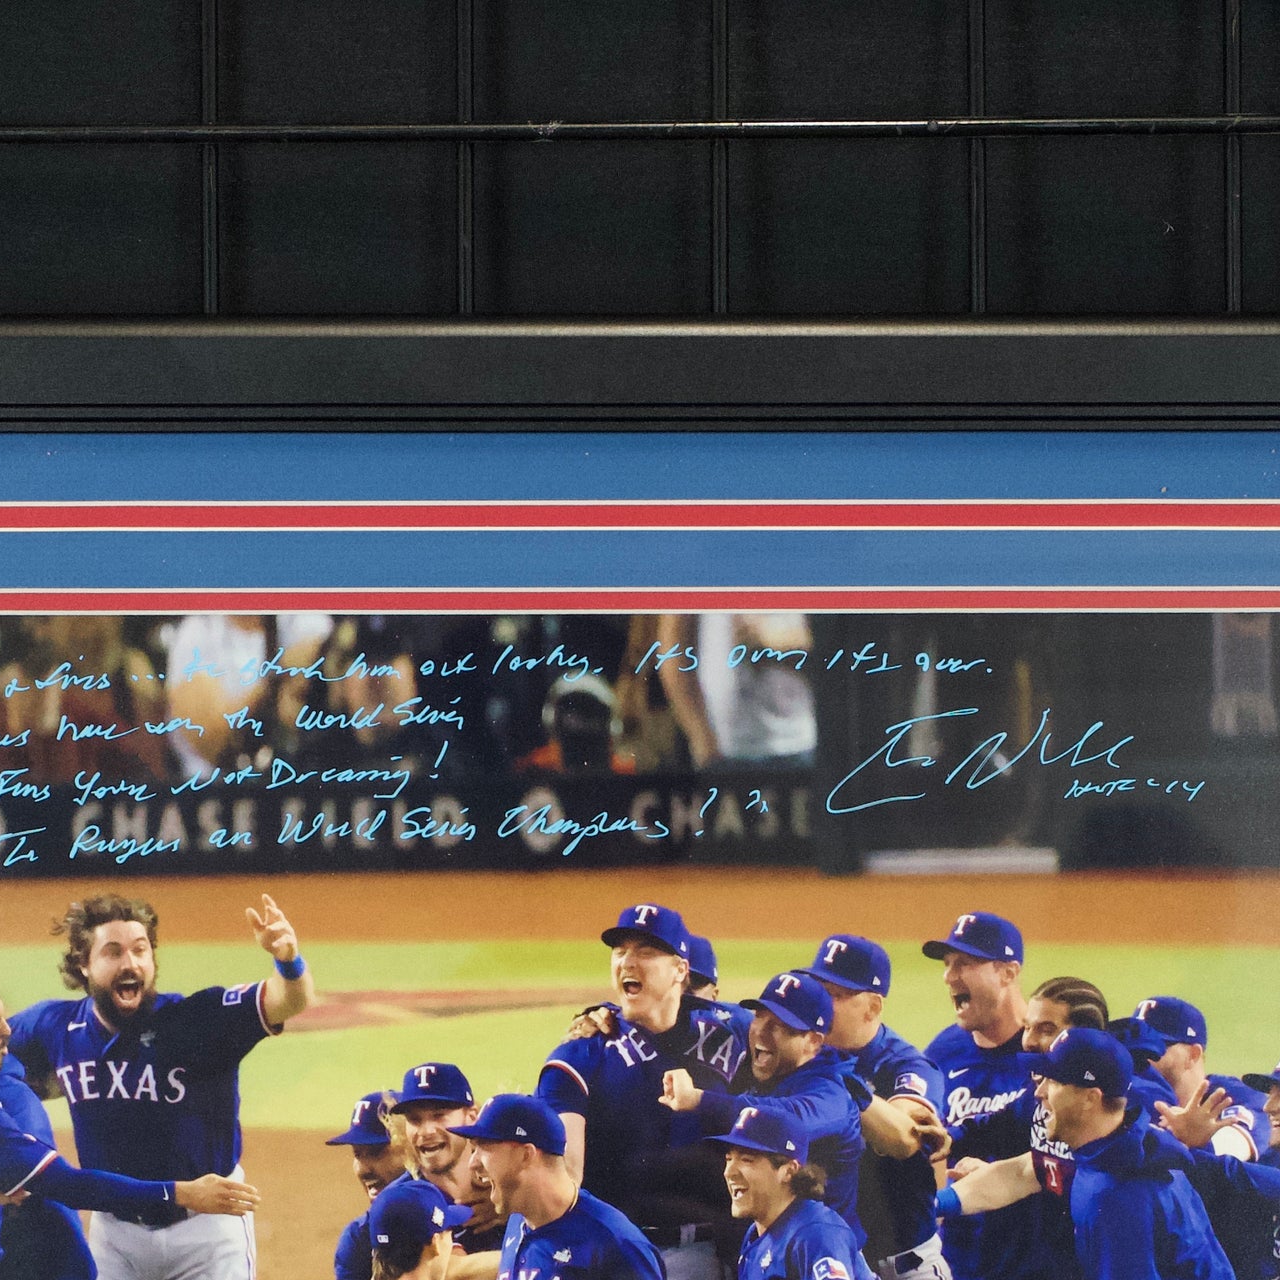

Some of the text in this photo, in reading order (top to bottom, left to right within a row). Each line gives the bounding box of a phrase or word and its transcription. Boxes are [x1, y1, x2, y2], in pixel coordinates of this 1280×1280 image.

[296, 703, 383, 731] World
[635, 905, 658, 926] T
[954, 914, 976, 936] T
[824, 940, 848, 964] T
[775, 974, 801, 998] T
[1136, 1000, 1157, 1020] T
[56, 1060, 186, 1105] TEXAS
[414, 1065, 436, 1088] T
[352, 1100, 371, 1124] T
[735, 1106, 759, 1130] T
[1044, 1159, 1058, 1188] T
